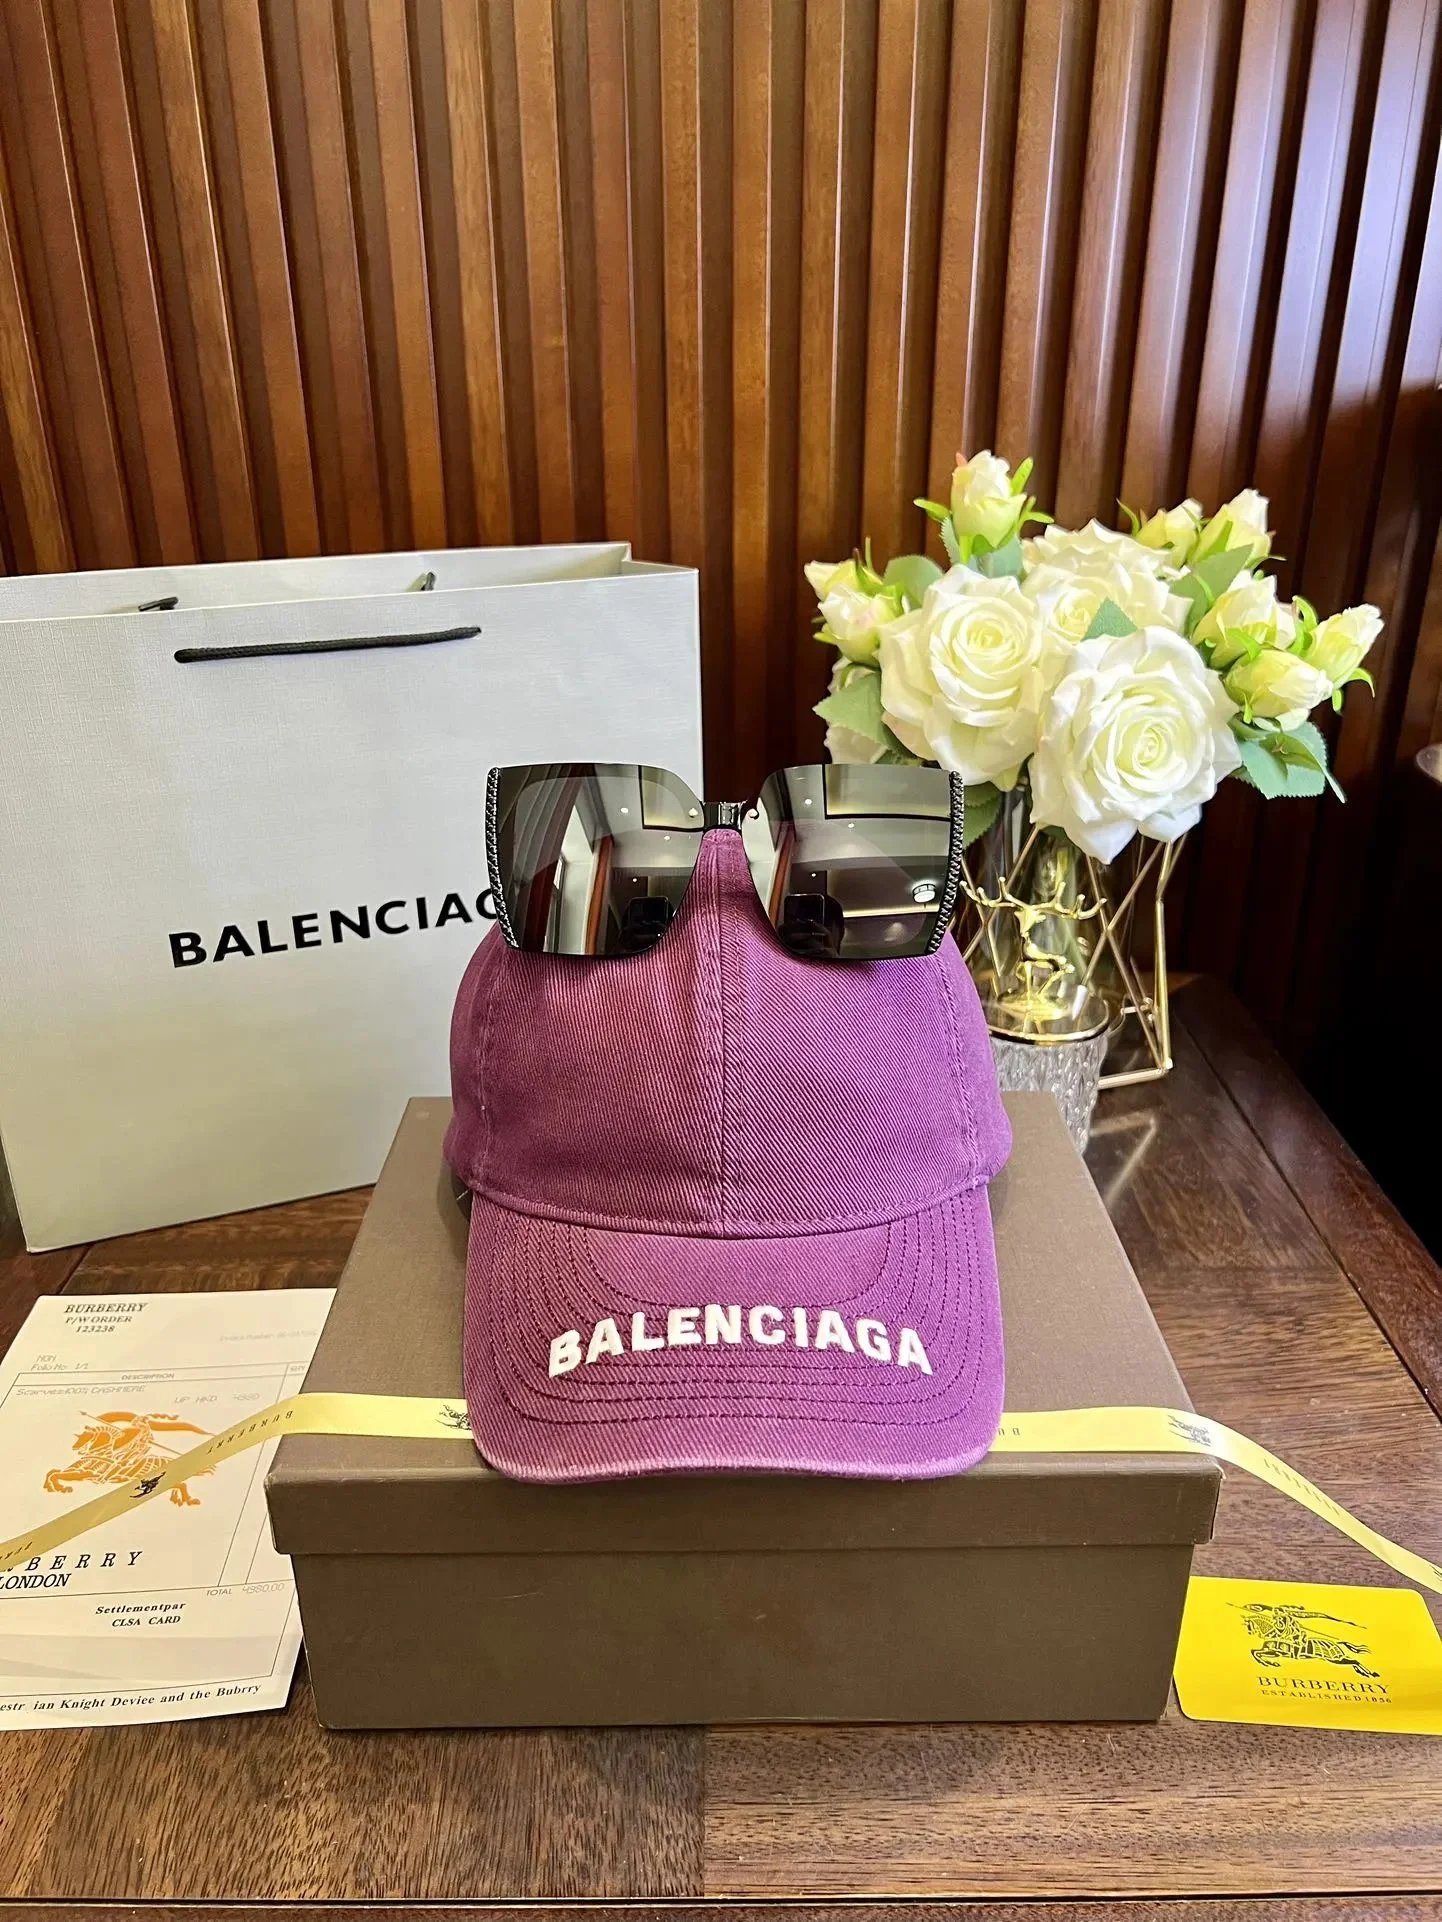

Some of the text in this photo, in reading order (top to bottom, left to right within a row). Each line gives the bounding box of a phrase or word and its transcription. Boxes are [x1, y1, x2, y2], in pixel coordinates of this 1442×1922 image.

[64, 1303, 149, 1313] BURBERRY
[548, 1304, 933, 1378] BALENCIAGA
[7, 1551, 143, 1572] BERRY
[206, 1588, 233, 1596] TOTAL
[95, 1603, 187, 1615] Settlementpar
[111, 1615, 182, 1627] CLSA CARD
[1257, 1676, 1391, 1694] BURBERRY
[0, 1702, 26, 1711] estr
[59, 1698, 105, 1710] Knight
[160, 1691, 185, 1703] and
[189, 1689, 211, 1700] the
[216, 1684, 262, 1697] Bubrry
[1261, 1689, 1363, 1702] ESTABLISHED
